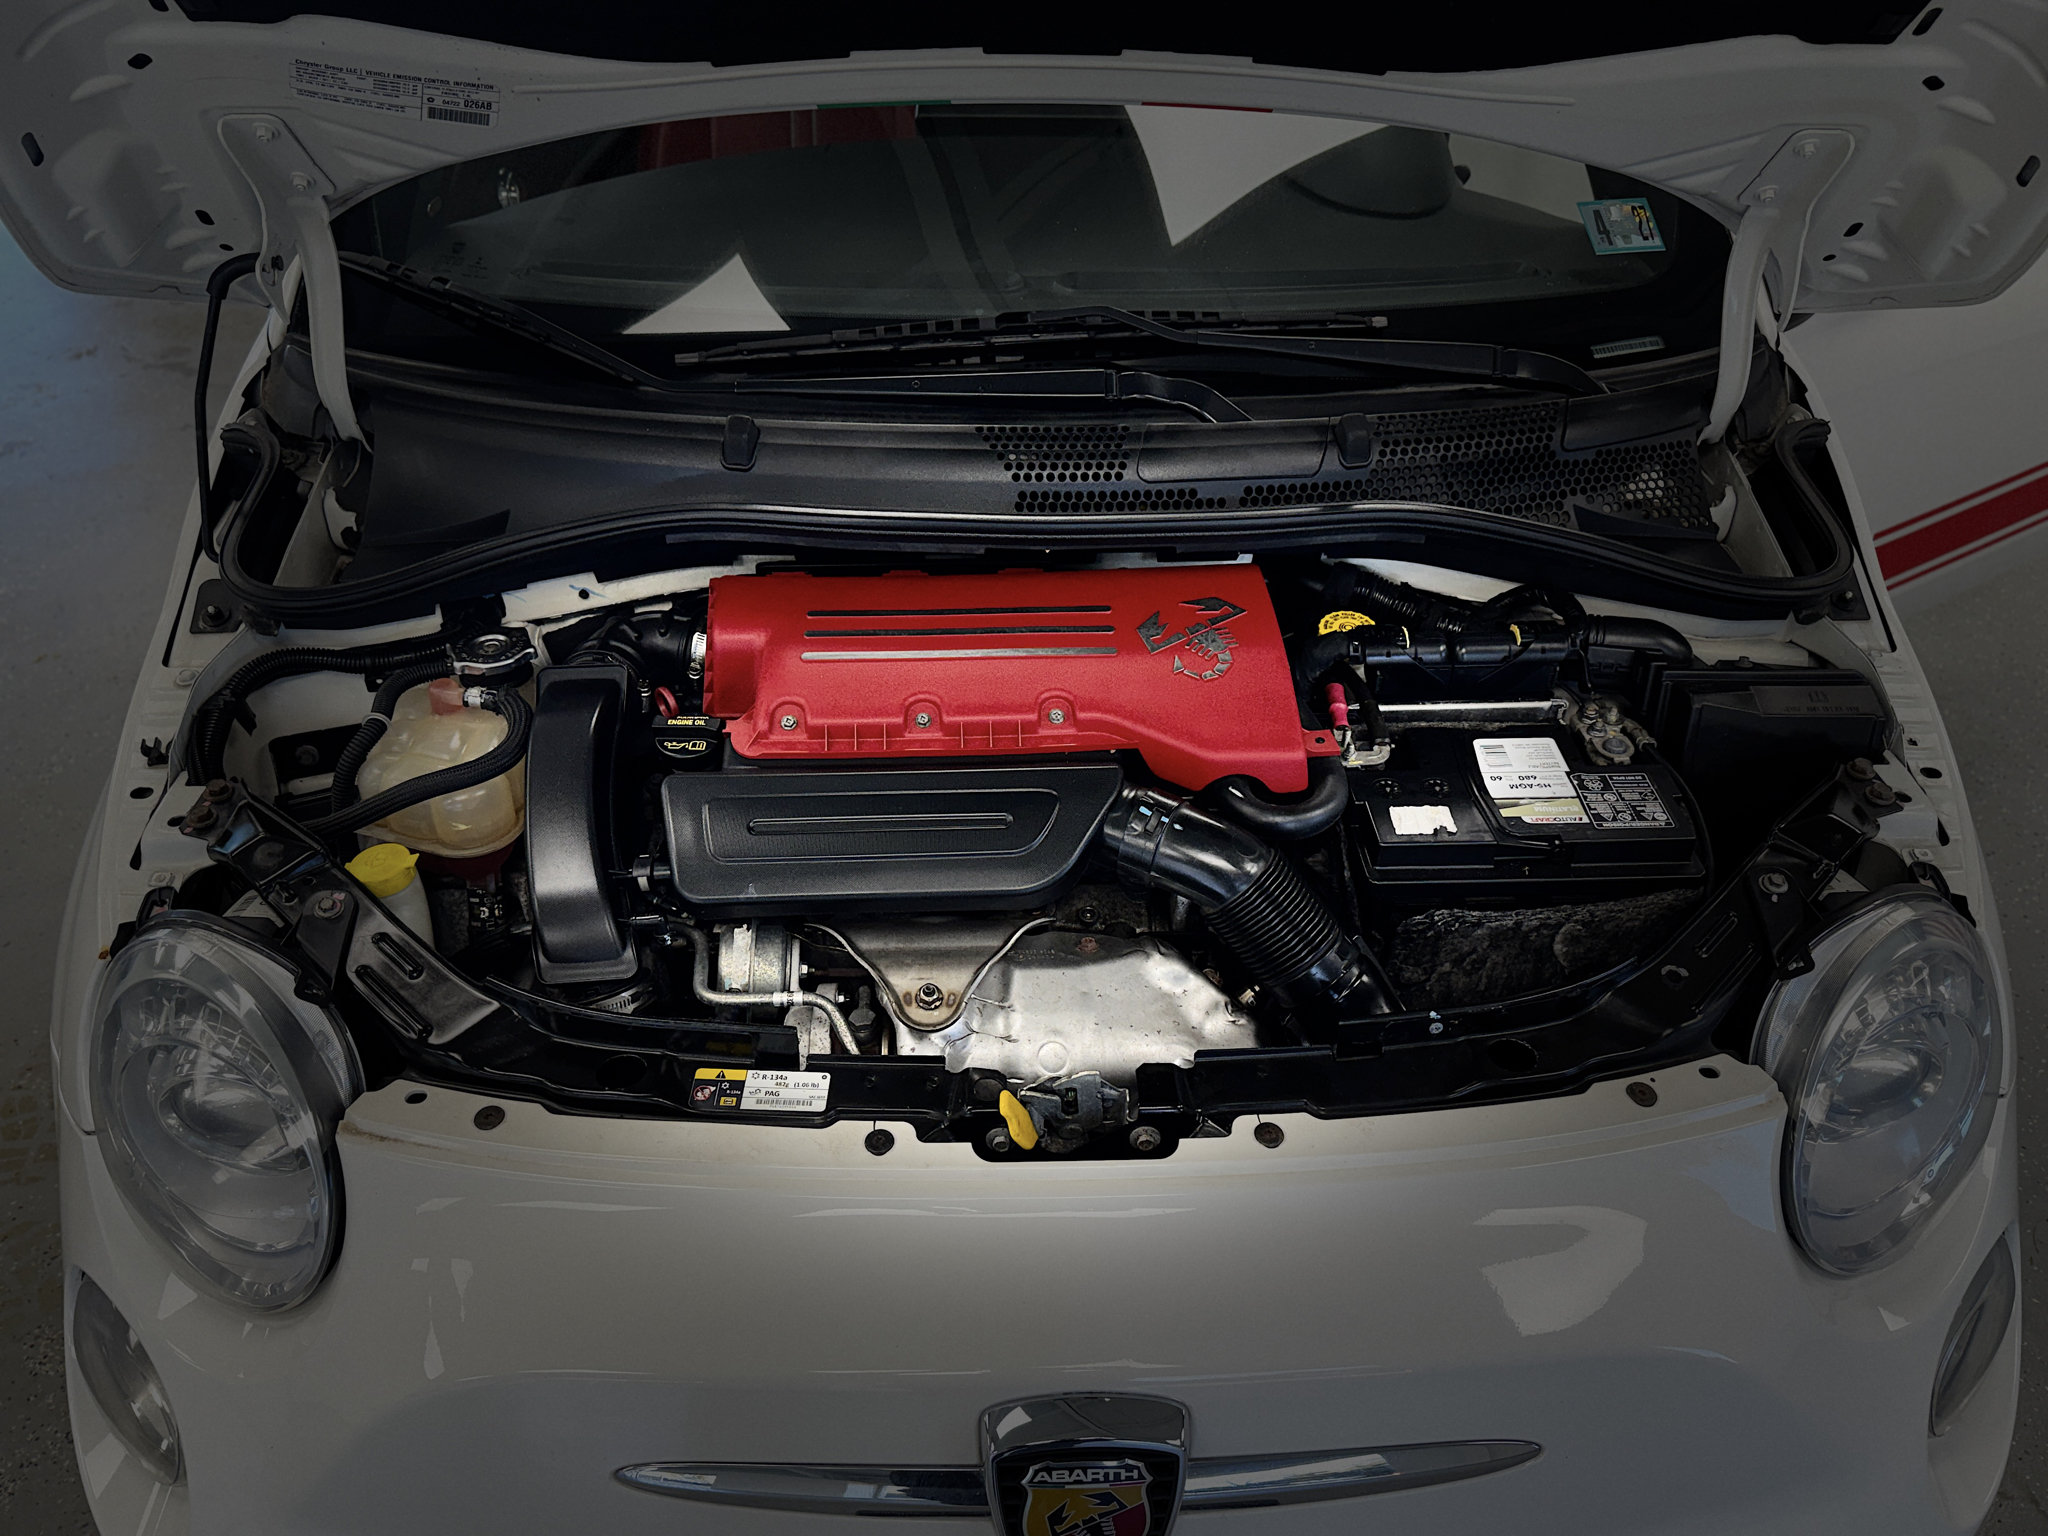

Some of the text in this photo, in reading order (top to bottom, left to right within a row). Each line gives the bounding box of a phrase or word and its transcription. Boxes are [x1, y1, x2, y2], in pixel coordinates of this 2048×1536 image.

[295, 59, 322, 68] Chrysler
[324, 64, 344, 72] Group
[365, 70, 390, 78] VEHICLE
[392, 74, 422, 82] EMISSION
[424, 77, 450, 86] CONTROL
[453, 81, 494, 90] INFORMATION
[1533, 805, 1580, 813] PLATINUM
[761, 1073, 788, 1081] R-134a
[1032, 1467, 1140, 1483] ABARTH
